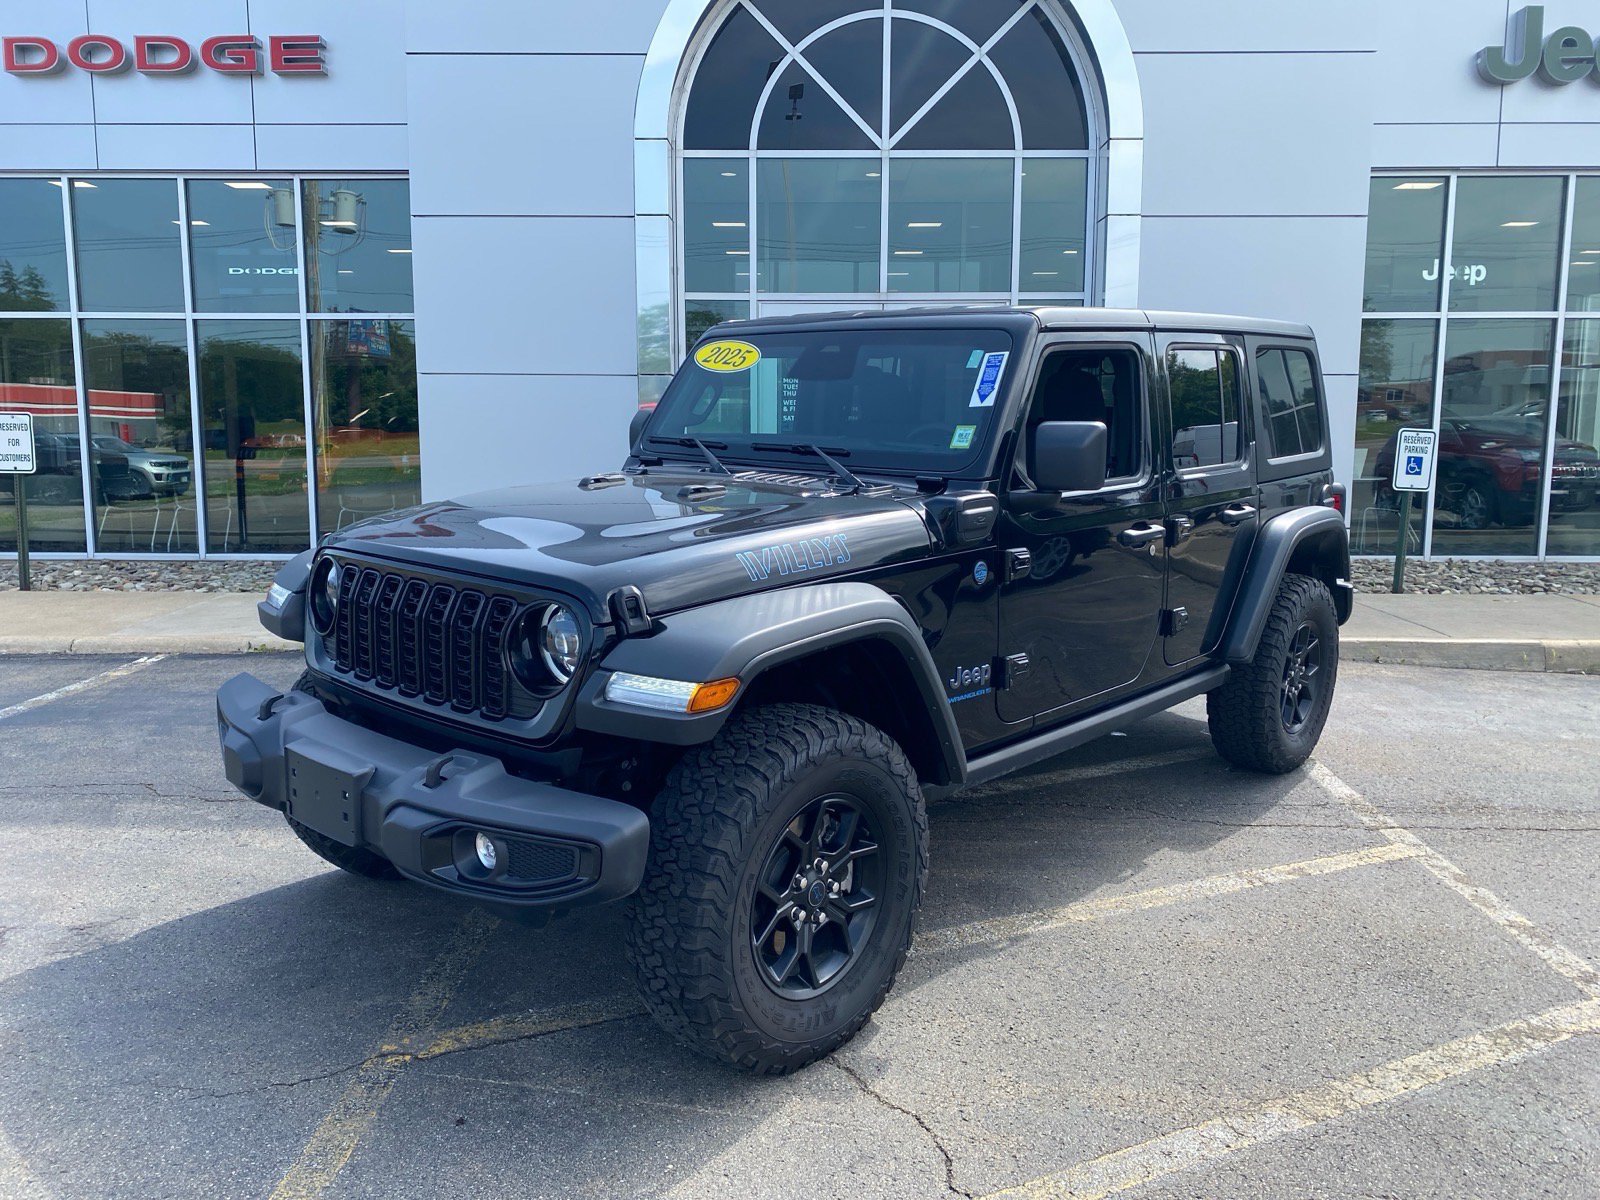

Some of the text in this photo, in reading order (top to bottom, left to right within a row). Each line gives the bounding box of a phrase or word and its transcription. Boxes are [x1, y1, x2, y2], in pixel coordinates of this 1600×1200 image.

[2, 34, 328, 76] DODGE
[1477, 5, 1600, 86] Je
[702, 346, 753, 367] 2025
[8, 438, 20, 447] FOR
[1403, 436, 1432, 445] RESERVED
[1404, 445, 1429, 455] PARKING
[735, 533, 851, 582] WILLYS
[949, 664, 992, 689] Jeep
